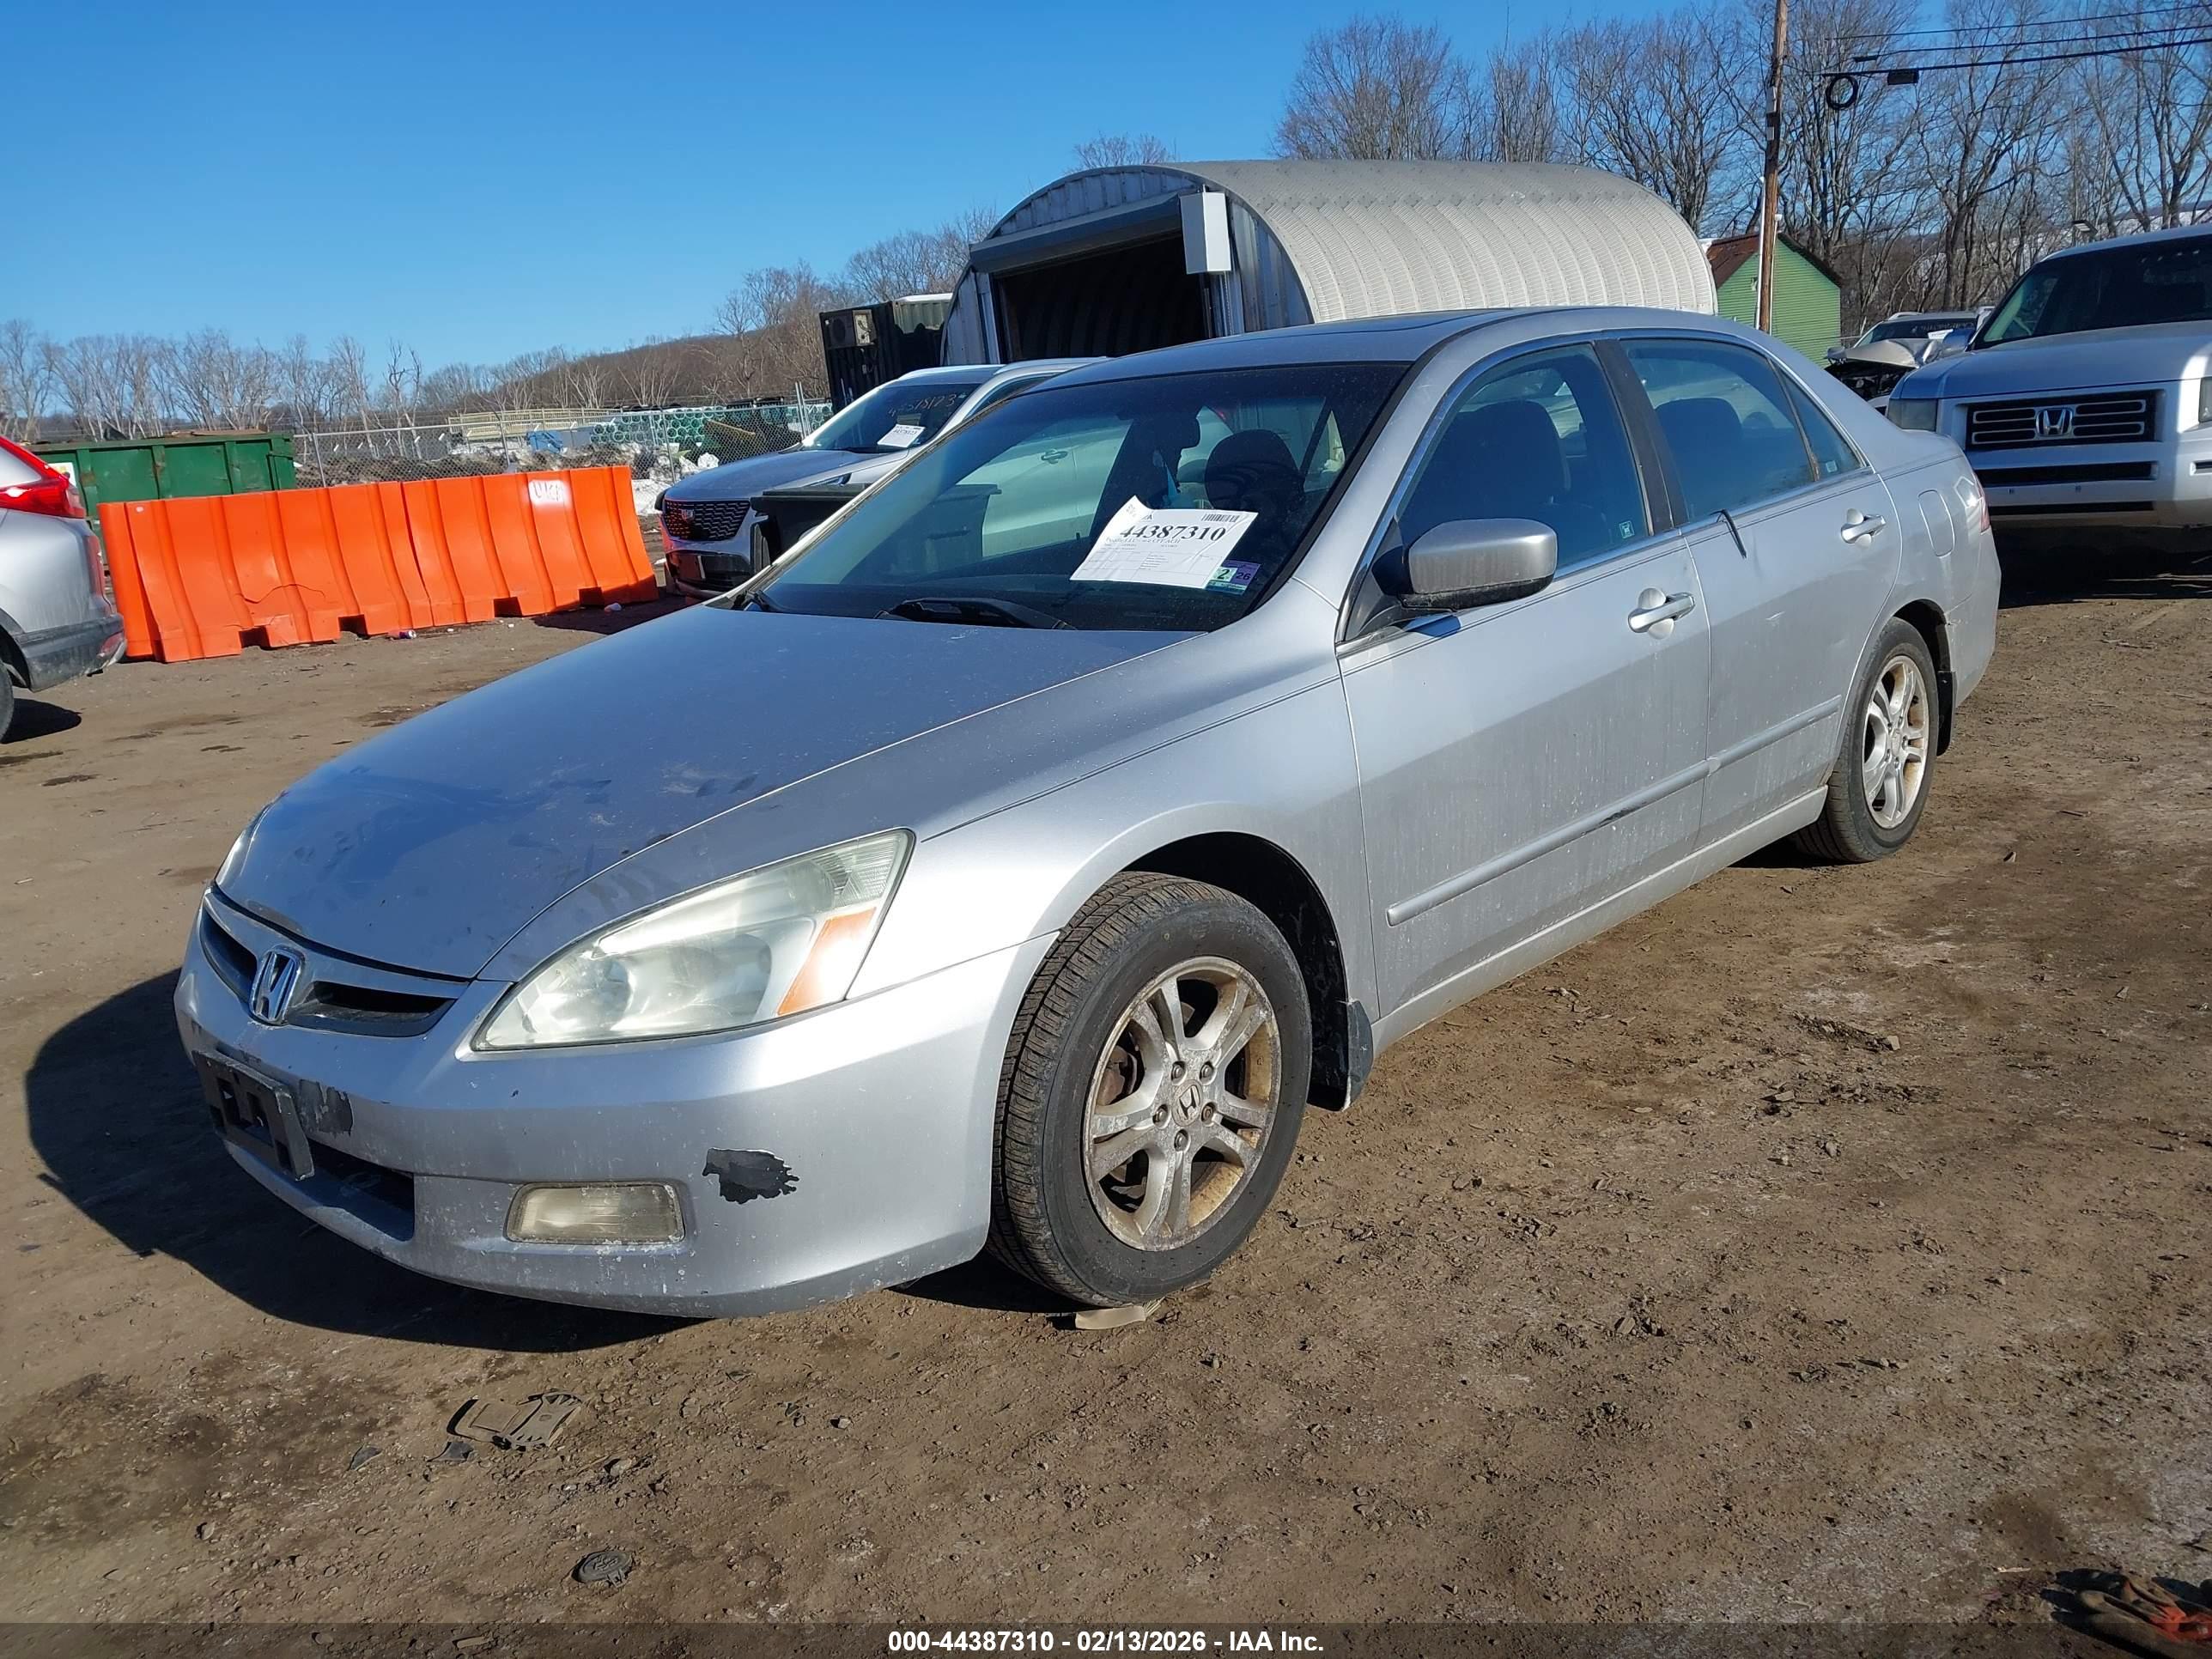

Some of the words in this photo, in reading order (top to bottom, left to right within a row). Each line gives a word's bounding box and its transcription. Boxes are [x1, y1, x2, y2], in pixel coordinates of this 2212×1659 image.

[1120, 525, 1226, 542] 44387310
[1217, 568, 1231, 580] 2
[1236, 572, 1251, 580] 26
